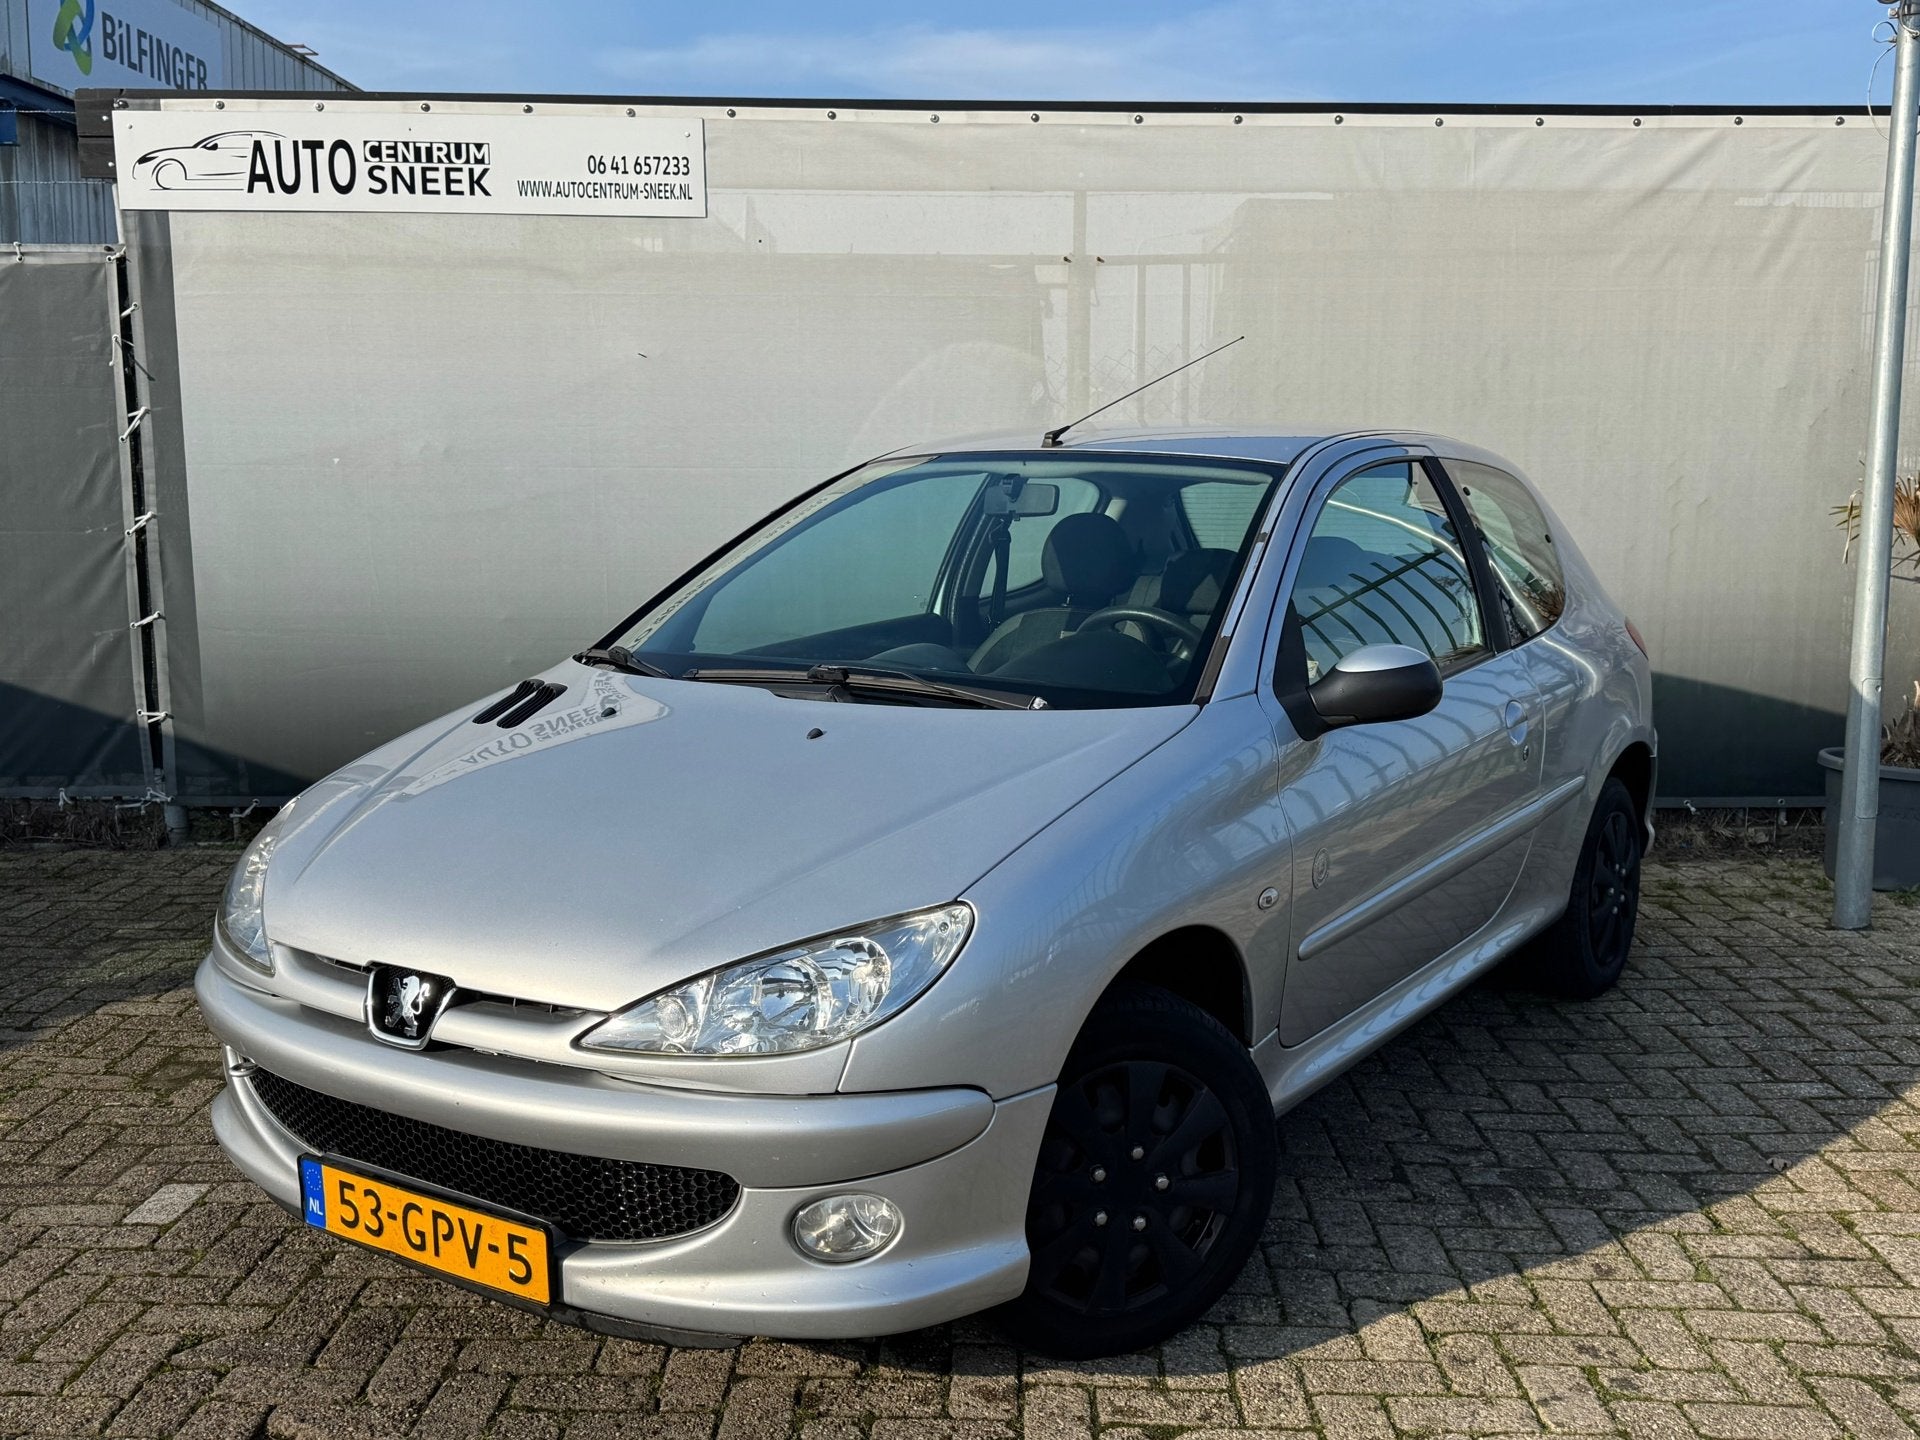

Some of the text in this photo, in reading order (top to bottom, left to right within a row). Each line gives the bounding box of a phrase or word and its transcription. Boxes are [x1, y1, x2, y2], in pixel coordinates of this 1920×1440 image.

[247, 139, 490, 195] AUTO CENTRUM
[587, 155, 690, 176] 06 41 657233
[367, 165, 492, 197] SNEEK
[517, 180, 693, 201] WWW.AUTOCENTRUM-SNEEK.NL
[309, 1196, 323, 1216] NL
[338, 1179, 532, 1285] 53-GPV-5
